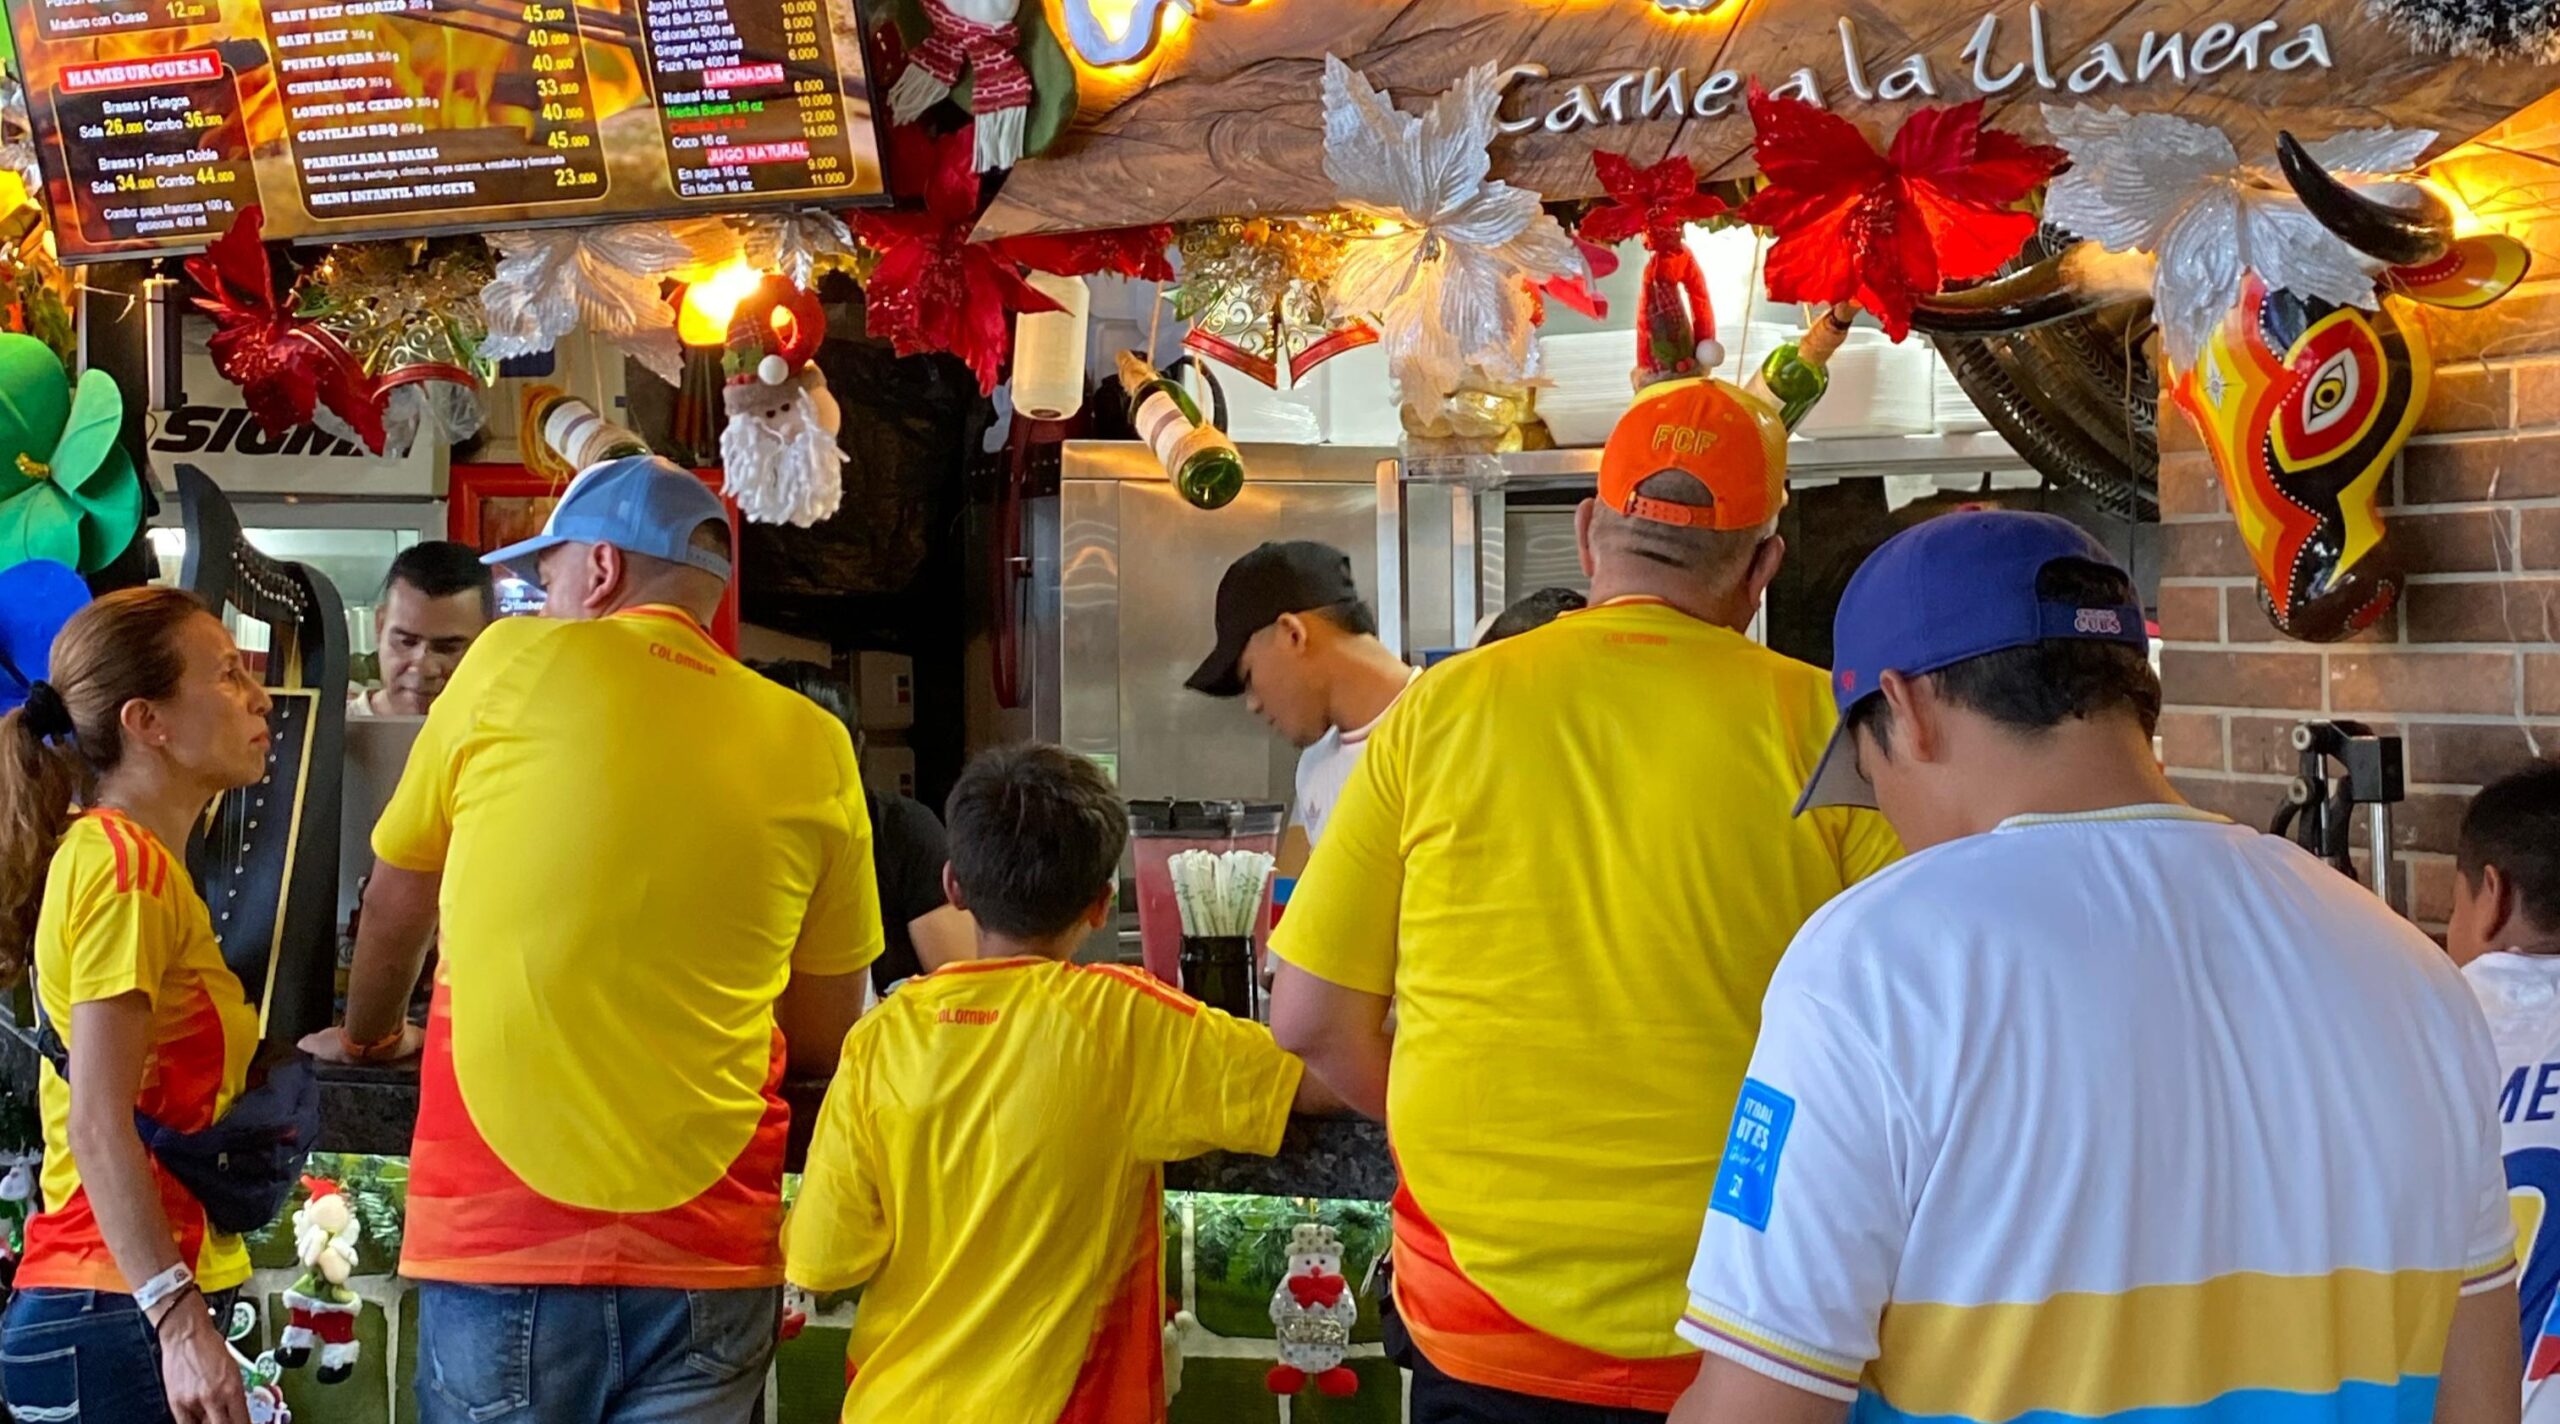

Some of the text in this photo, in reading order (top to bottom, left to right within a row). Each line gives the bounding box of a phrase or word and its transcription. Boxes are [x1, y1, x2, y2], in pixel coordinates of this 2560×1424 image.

[49, 1, 205, 31] Maduro con Queso 12.000
[271, 9, 307, 24] BABY
[308, 5, 343, 20] BEEF
[345, 0, 407, 16] CHORIZO
[649, 1, 817, 27] Red Bull 250 ml 10.000
[276, 33, 312, 48] BABY
[313, 29, 349, 44] BEEF
[522, 4, 565, 23] 45.000
[651, 16, 813, 42] Gatorade 500 ml 8.000
[281, 56, 326, 72] PUNTA
[326, 52, 375, 67] GORDA
[527, 29, 570, 48] 40.000
[655, 31, 815, 58] Ginger Ale 300 ml 7.000
[67, 57, 214, 87] HAMBURGUESA
[287, 77, 366, 95] CHURRASCO
[532, 54, 574, 72] 40.000
[657, 59, 684, 73] Fuze
[684, 58, 704, 70] Tea
[705, 55, 725, 68] 400
[726, 54, 740, 67] ml
[704, 65, 783, 84] LIMONADAS
[1497, 63, 1744, 133] Carne
[1838, 16, 1936, 100] la
[1960, 1, 2332, 95] Llanera
[102, 96, 190, 114] Brasas y Fuegos
[291, 103, 345, 119] LOMITO
[345, 101, 365, 115] DE
[367, 97, 414, 112] CERDO
[536, 79, 579, 97] 33.000
[663, 91, 700, 105] Natural
[702, 90, 716, 101] 16
[717, 90, 730, 100] oz
[701, 103, 735, 117] Buena
[736, 101, 749, 113] 16
[751, 101, 764, 112] oz
[797, 94, 833, 107] 10.000
[79, 111, 223, 139] Sola 26.000 Combo 36.000
[297, 125, 367, 142] COSTILLAS
[369, 123, 398, 138] BBQ
[542, 103, 584, 121] 40.000
[800, 110, 835, 123] 12.000
[302, 131, 590, 170] PARRILLADA BRASAS 45.000
[672, 125, 838, 149] Coco 16 oz 14.000
[98, 148, 218, 171] Brasas y Fuegos Doble
[707, 143, 809, 163] JUGO NATURAL
[91, 166, 235, 194] Sola 34.000 Combo 44.000
[678, 157, 837, 181] En agua 16 oz 9.000
[310, 168, 597, 205] MENU INFANTIL NUGGETS 23.000
[681, 172, 845, 195] En leche 16 oz 11.000
[151, 405, 417, 458] SIGM
[1651, 424, 1718, 456] FCF
[649, 642, 717, 677] COLOMBIA
